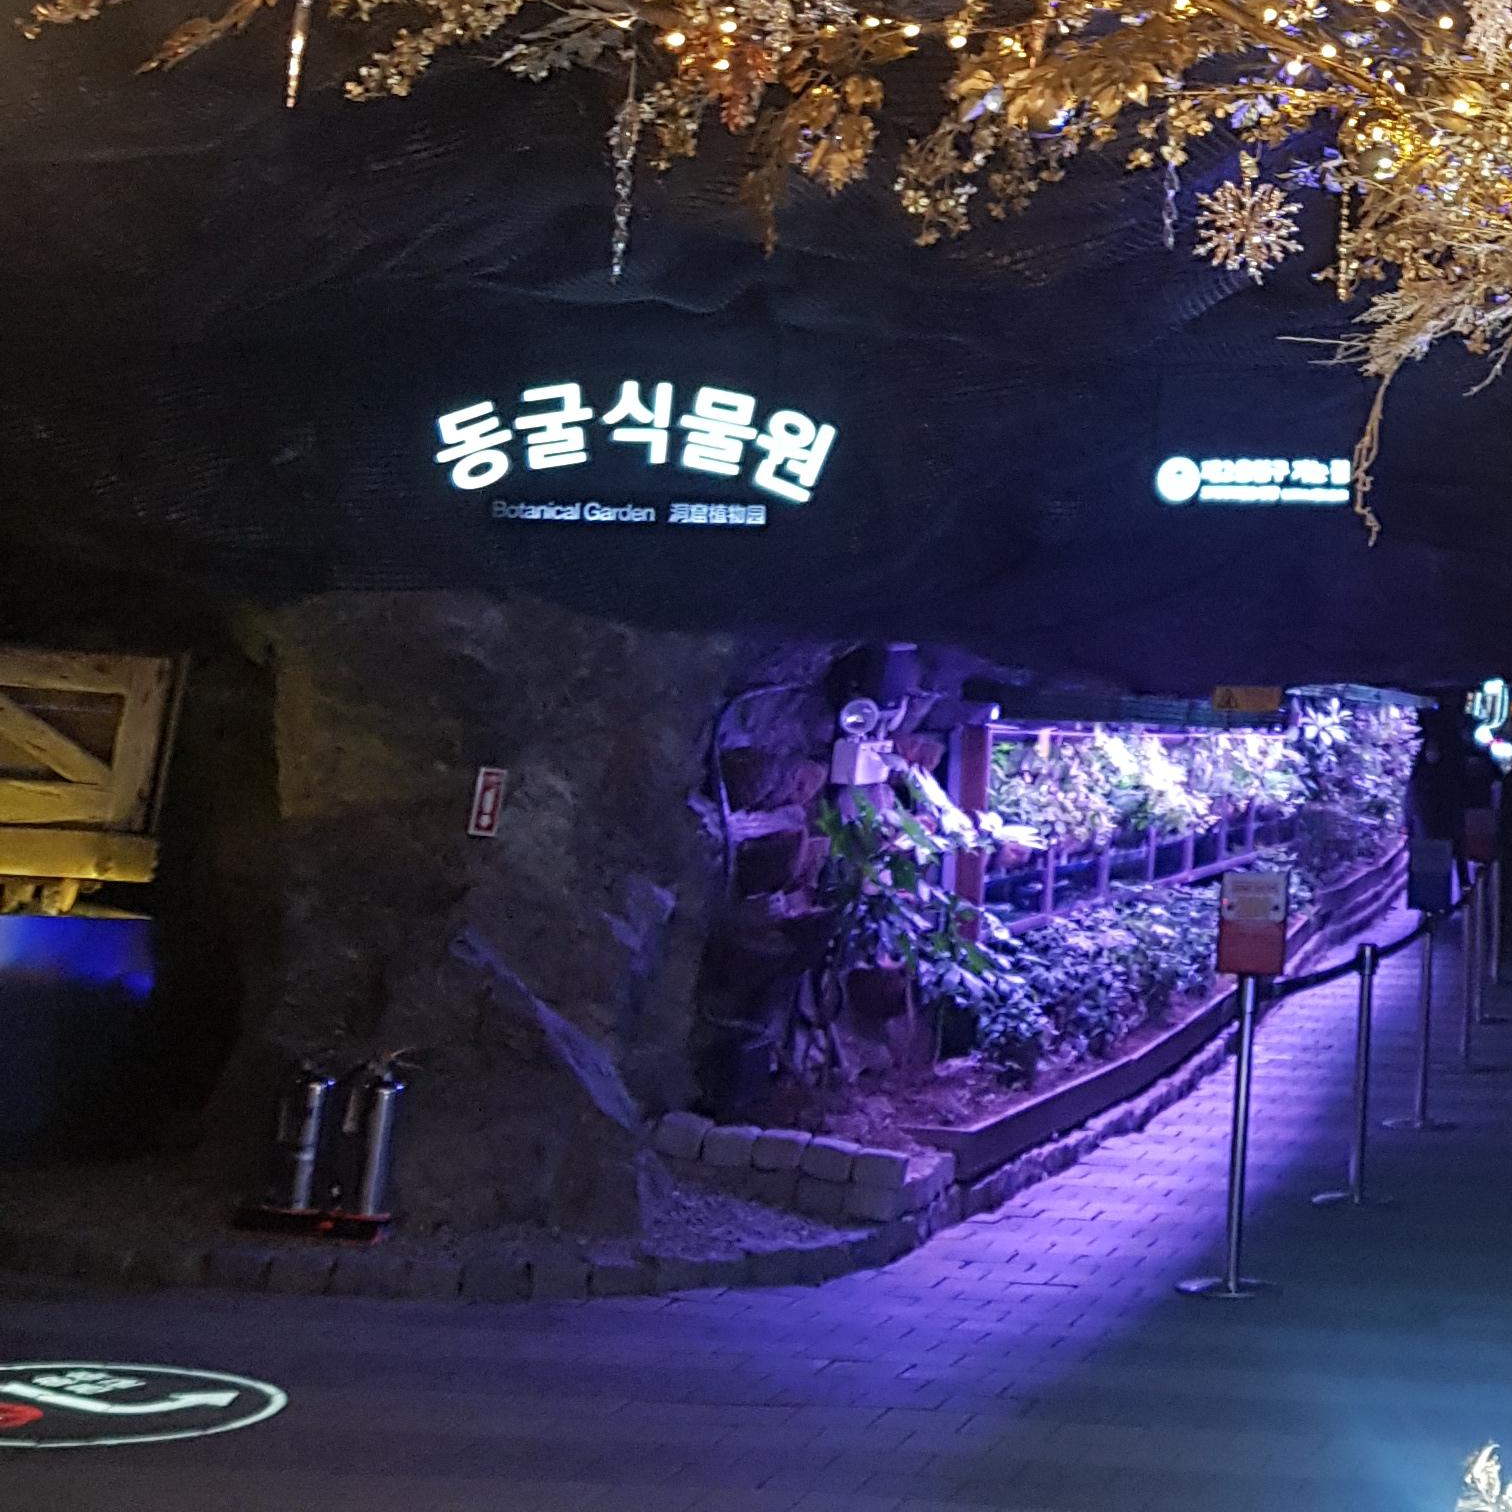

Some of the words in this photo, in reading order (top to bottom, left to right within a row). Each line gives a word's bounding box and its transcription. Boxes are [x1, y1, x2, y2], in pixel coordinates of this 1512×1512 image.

[434, 380, 836, 502] 동굴식물원
[492, 500, 581, 520] Botanical
[583, 501, 656, 522] Garden
